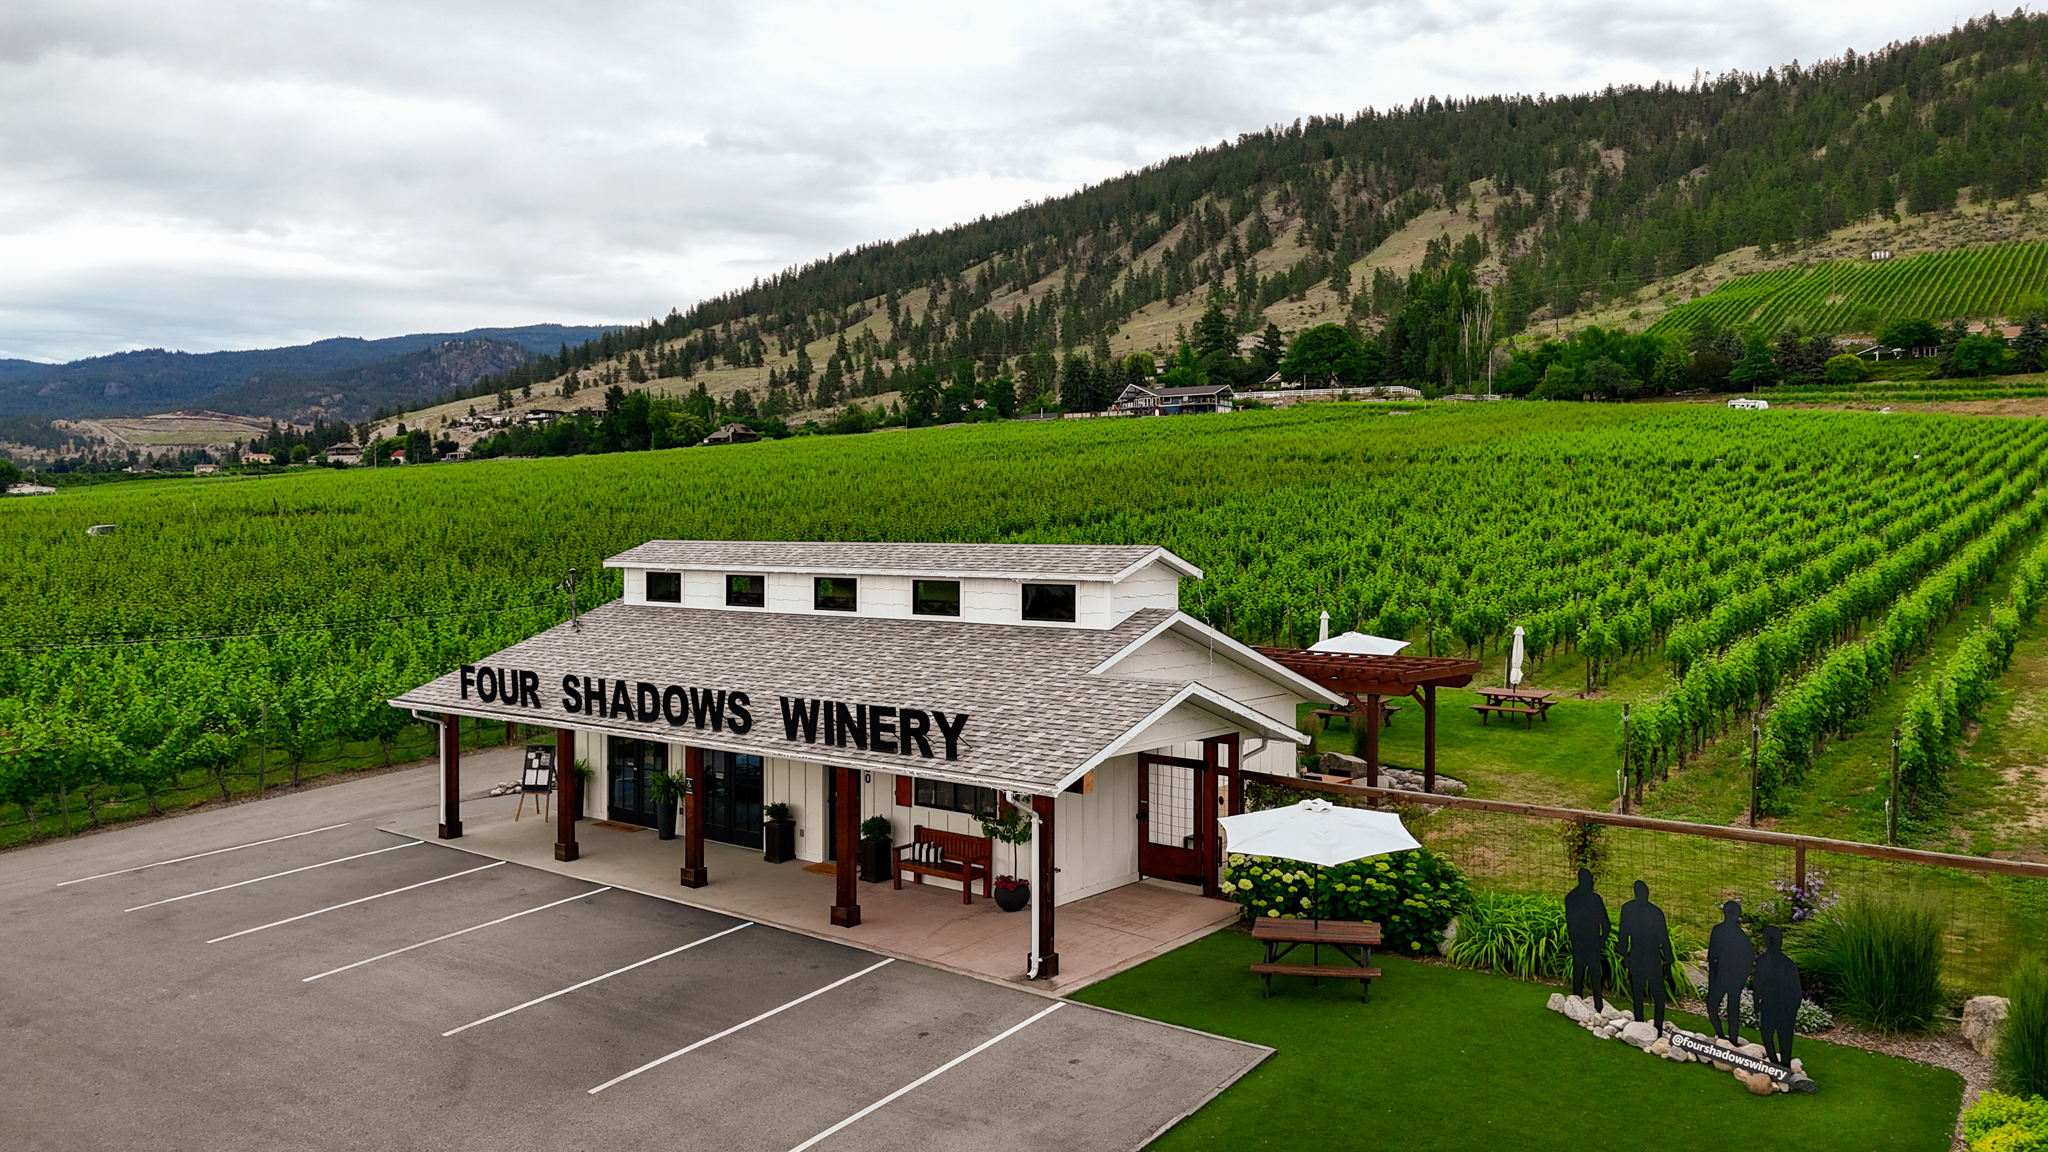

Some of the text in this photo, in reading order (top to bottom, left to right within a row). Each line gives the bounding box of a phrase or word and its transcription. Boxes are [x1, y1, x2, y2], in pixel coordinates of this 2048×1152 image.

[460, 665, 970, 761] FOUR SHADOWS WINERY
[1672, 1034, 1788, 1080] @fourshadowswinery
